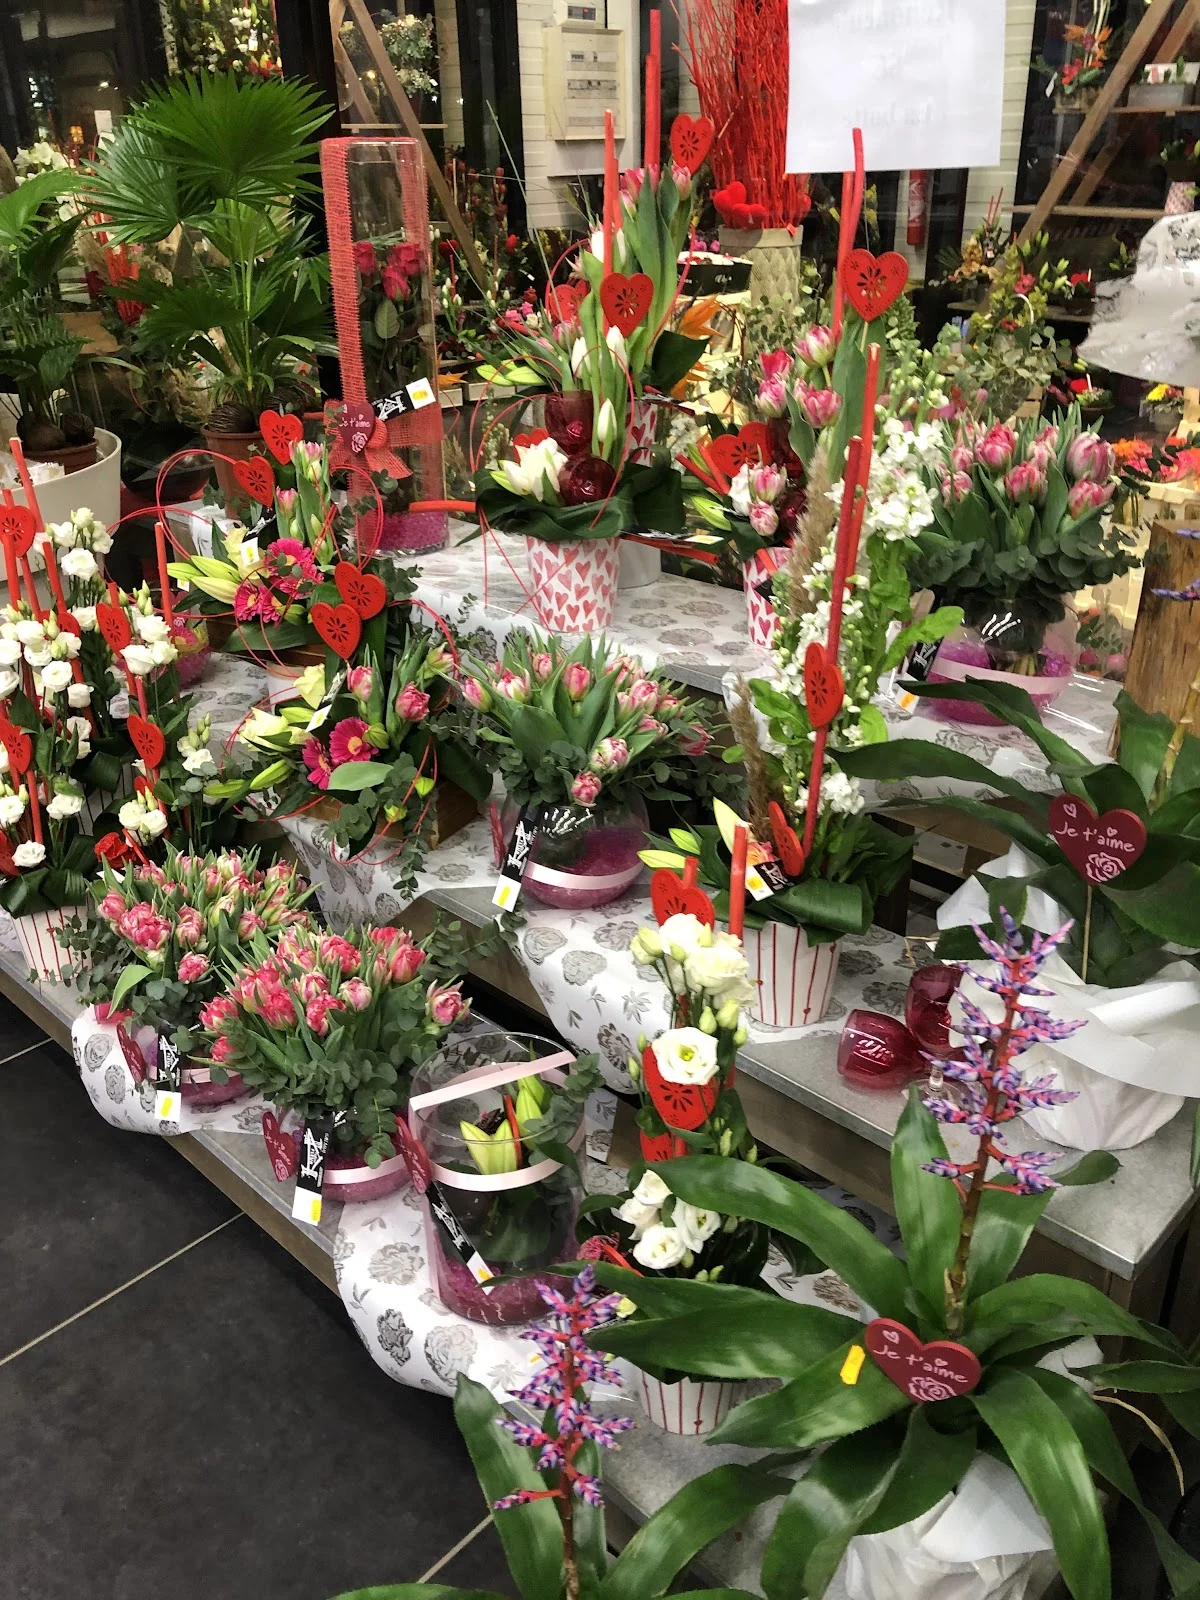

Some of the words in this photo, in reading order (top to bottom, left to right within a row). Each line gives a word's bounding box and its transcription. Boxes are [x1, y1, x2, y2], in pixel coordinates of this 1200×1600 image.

[1055, 821, 1078, 837] Je
[1083, 827, 1135, 852] t'aime
[873, 1345, 900, 1359] Je
[906, 1354, 968, 1383] t'aime
